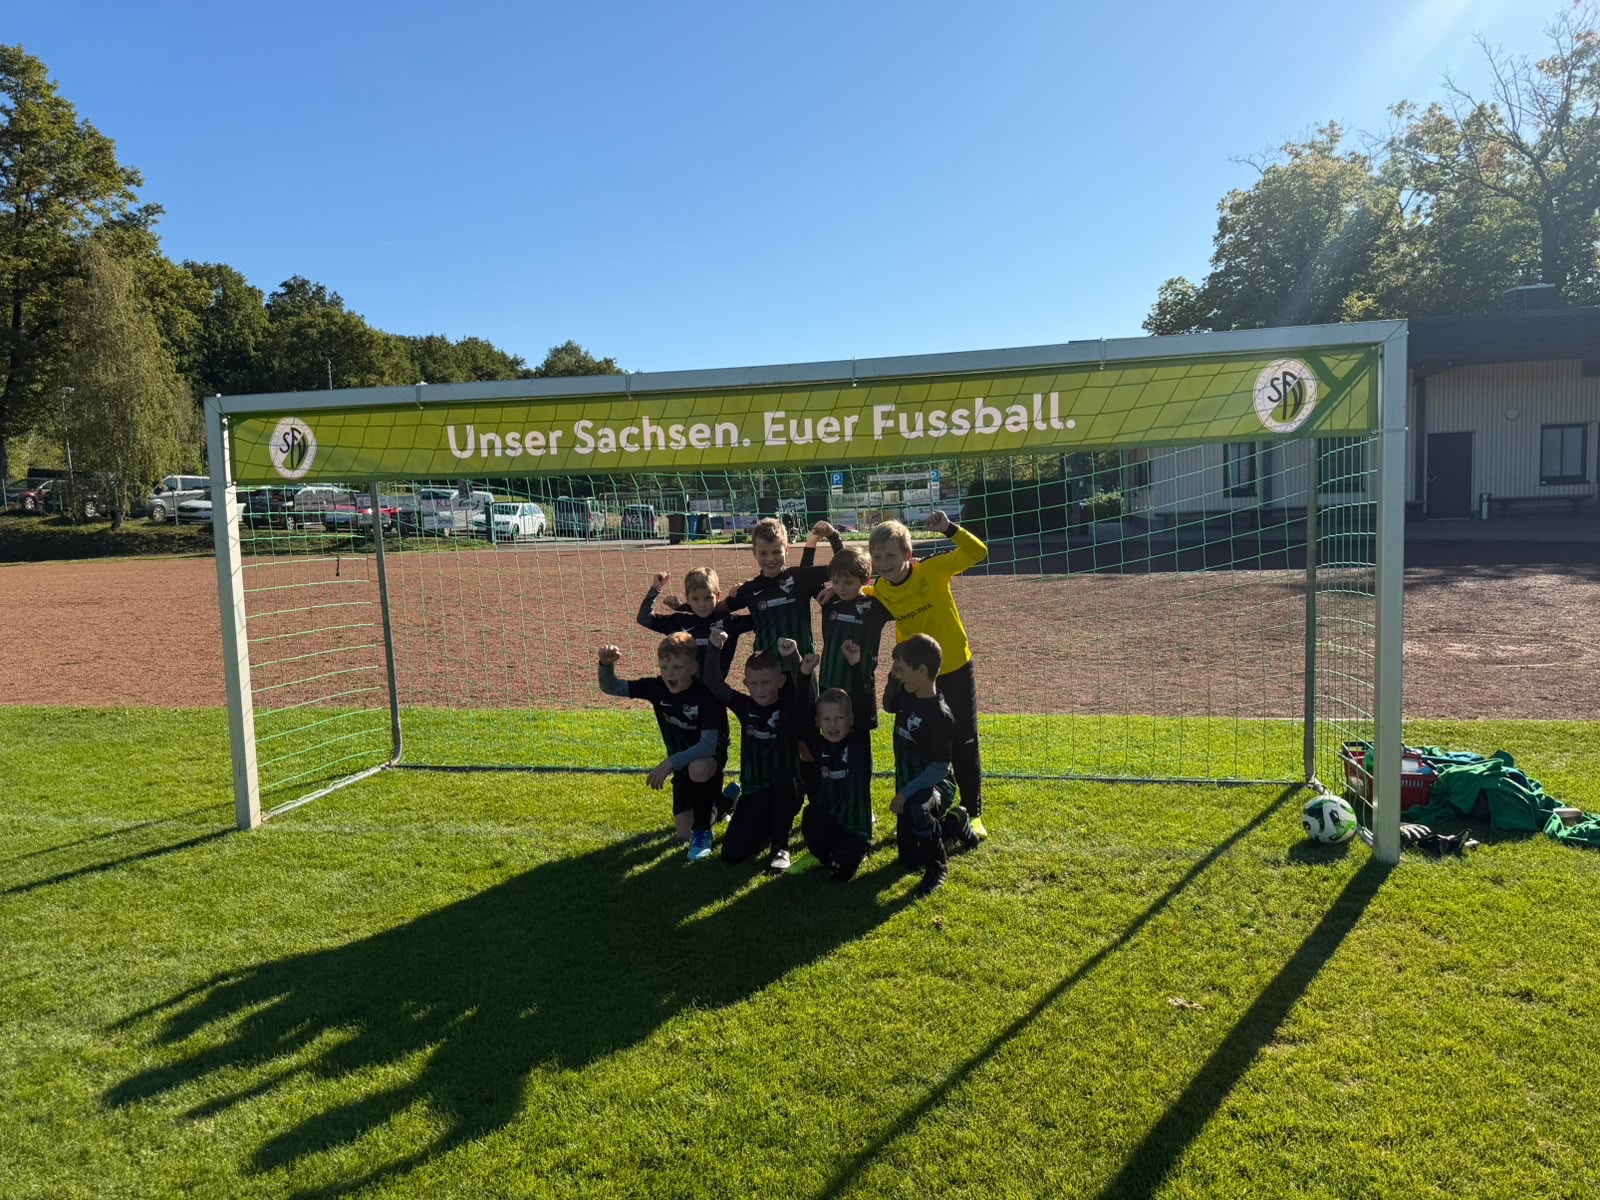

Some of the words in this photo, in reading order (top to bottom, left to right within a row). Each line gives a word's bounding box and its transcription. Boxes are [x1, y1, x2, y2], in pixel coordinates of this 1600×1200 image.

[446, 424, 562, 459] Unser
[574, 416, 750, 455] Sachsen.
[764, 411, 858, 446] Euer
[874, 392, 1076, 441] Fussball.
